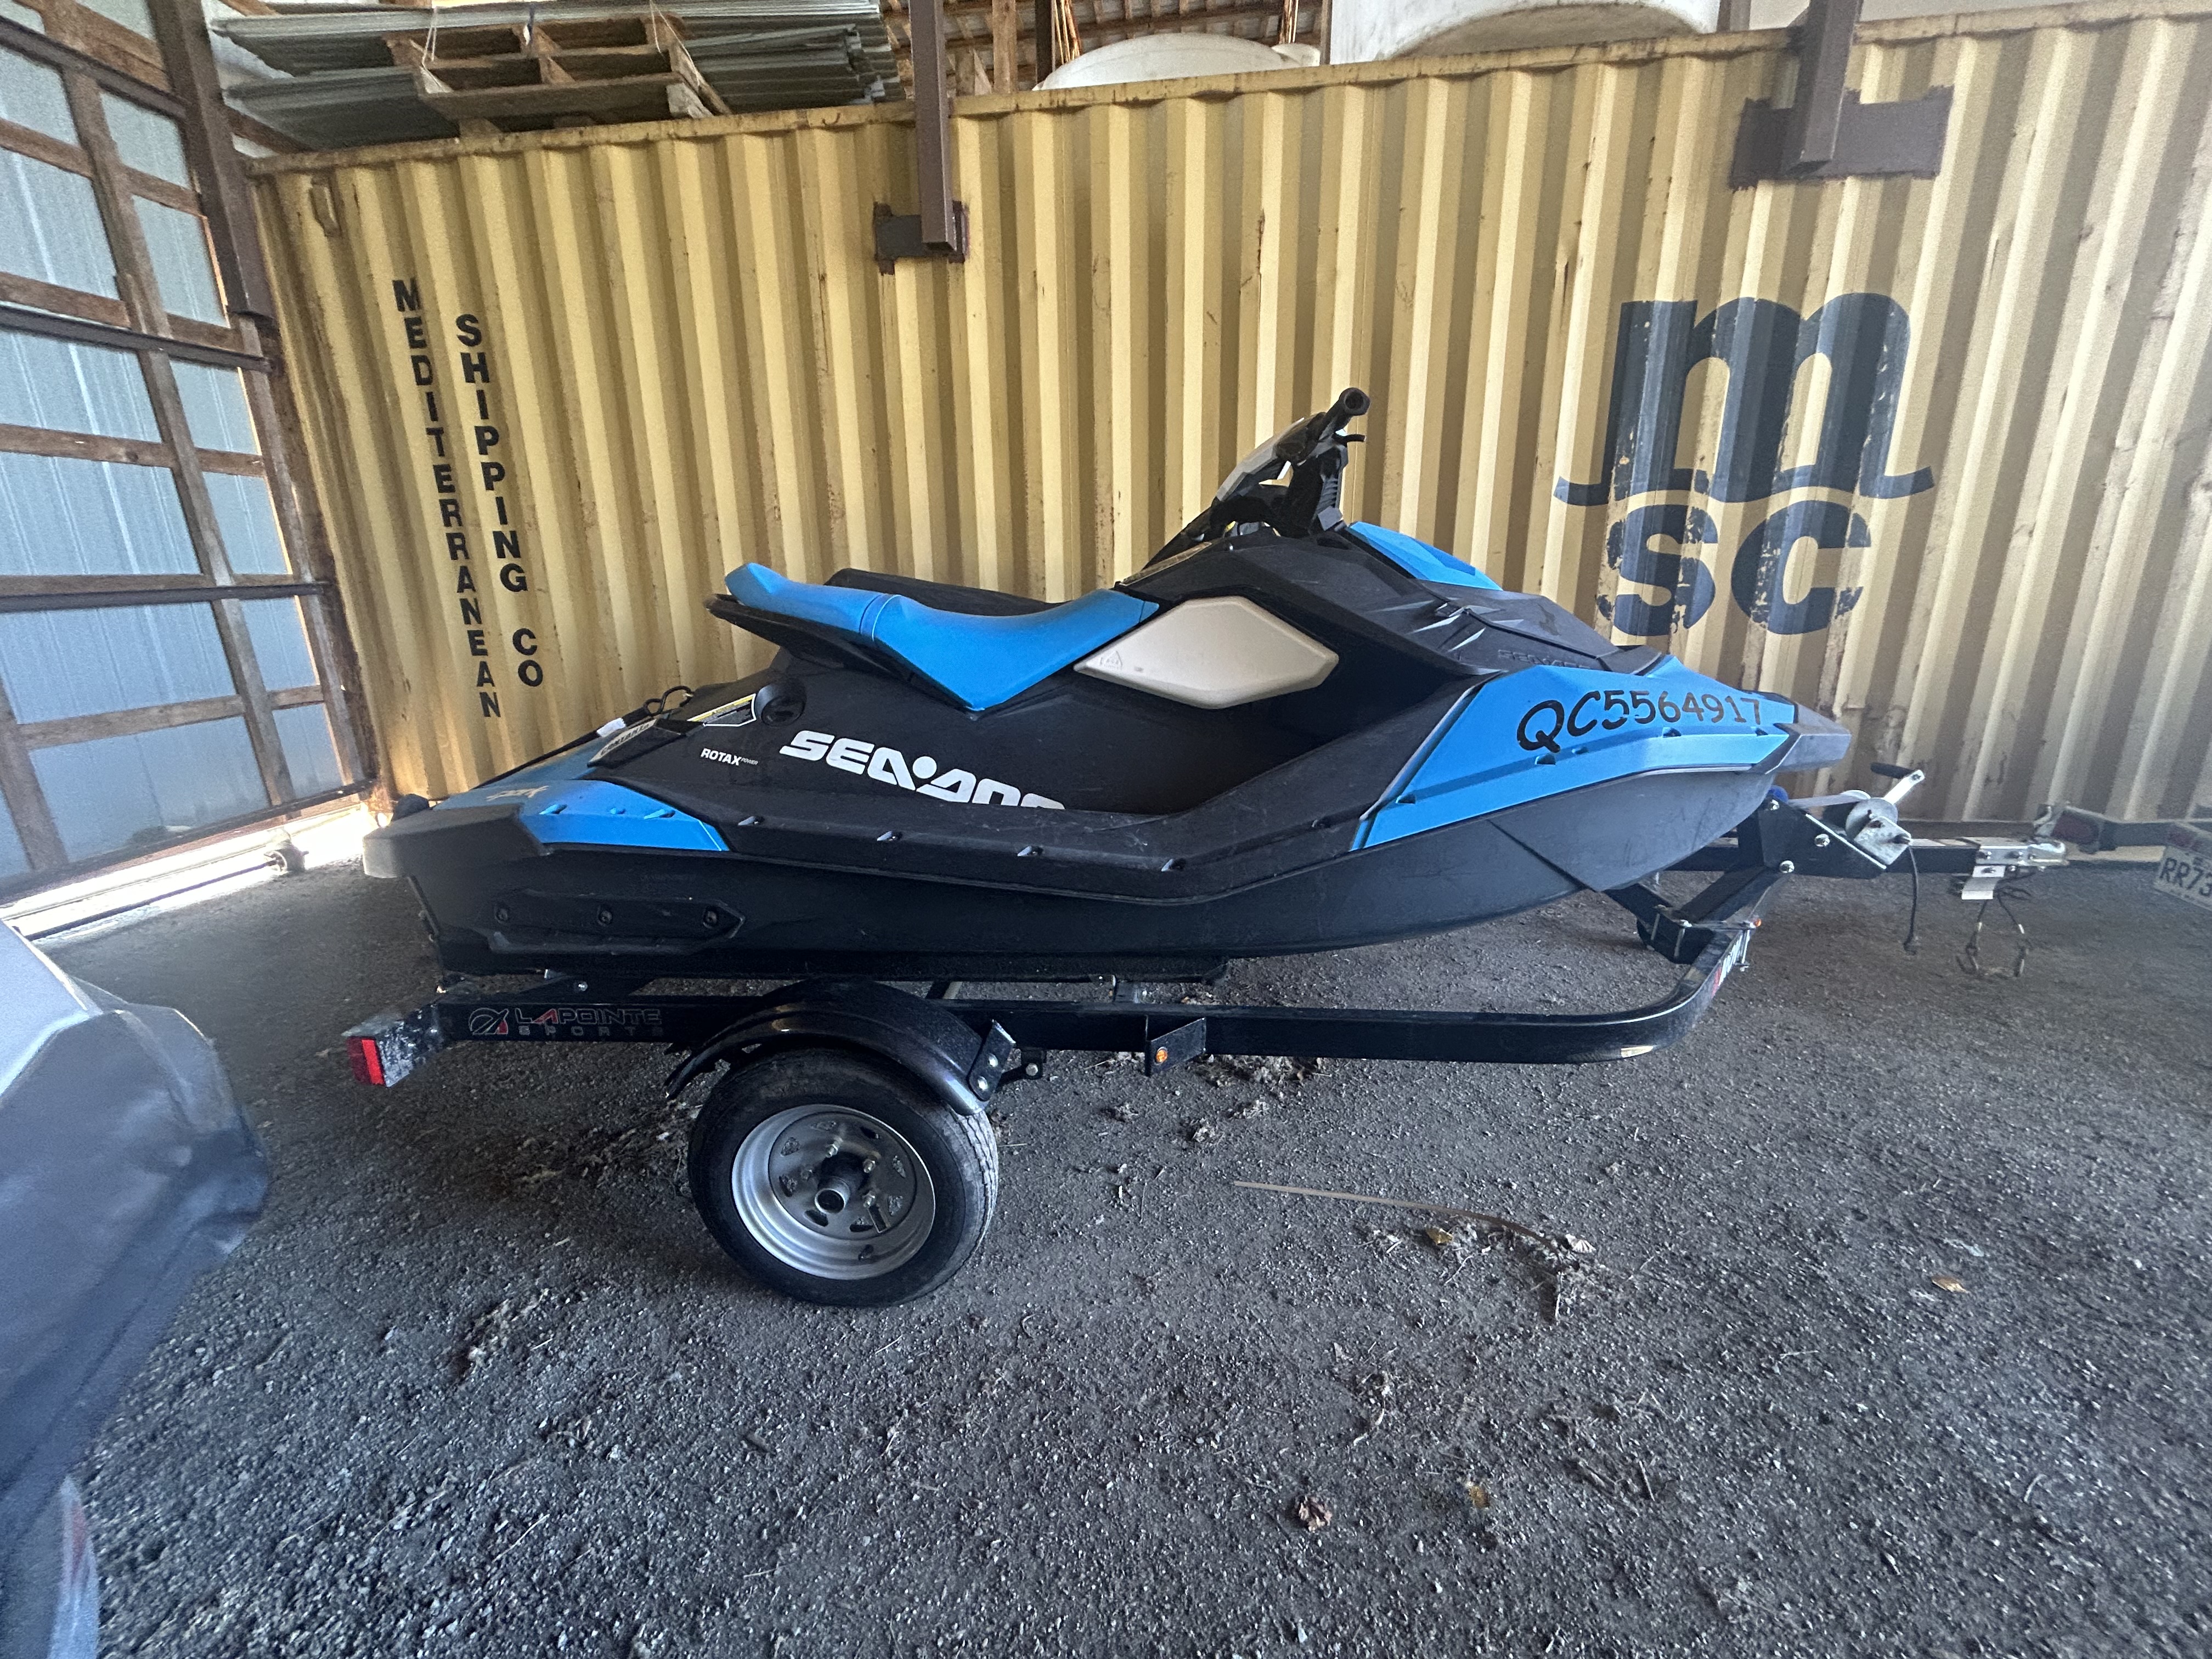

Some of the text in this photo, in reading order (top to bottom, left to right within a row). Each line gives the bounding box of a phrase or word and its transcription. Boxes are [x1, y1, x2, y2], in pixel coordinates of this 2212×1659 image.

[392, 279, 501, 718] MEDITERRANEAN
[456, 313, 544, 687] SHIPPING CO
[1516, 690, 1761, 753] QC5564917
[701, 748, 742, 766] ROTAX
[515, 1007, 662, 1025] LAPOINTE
